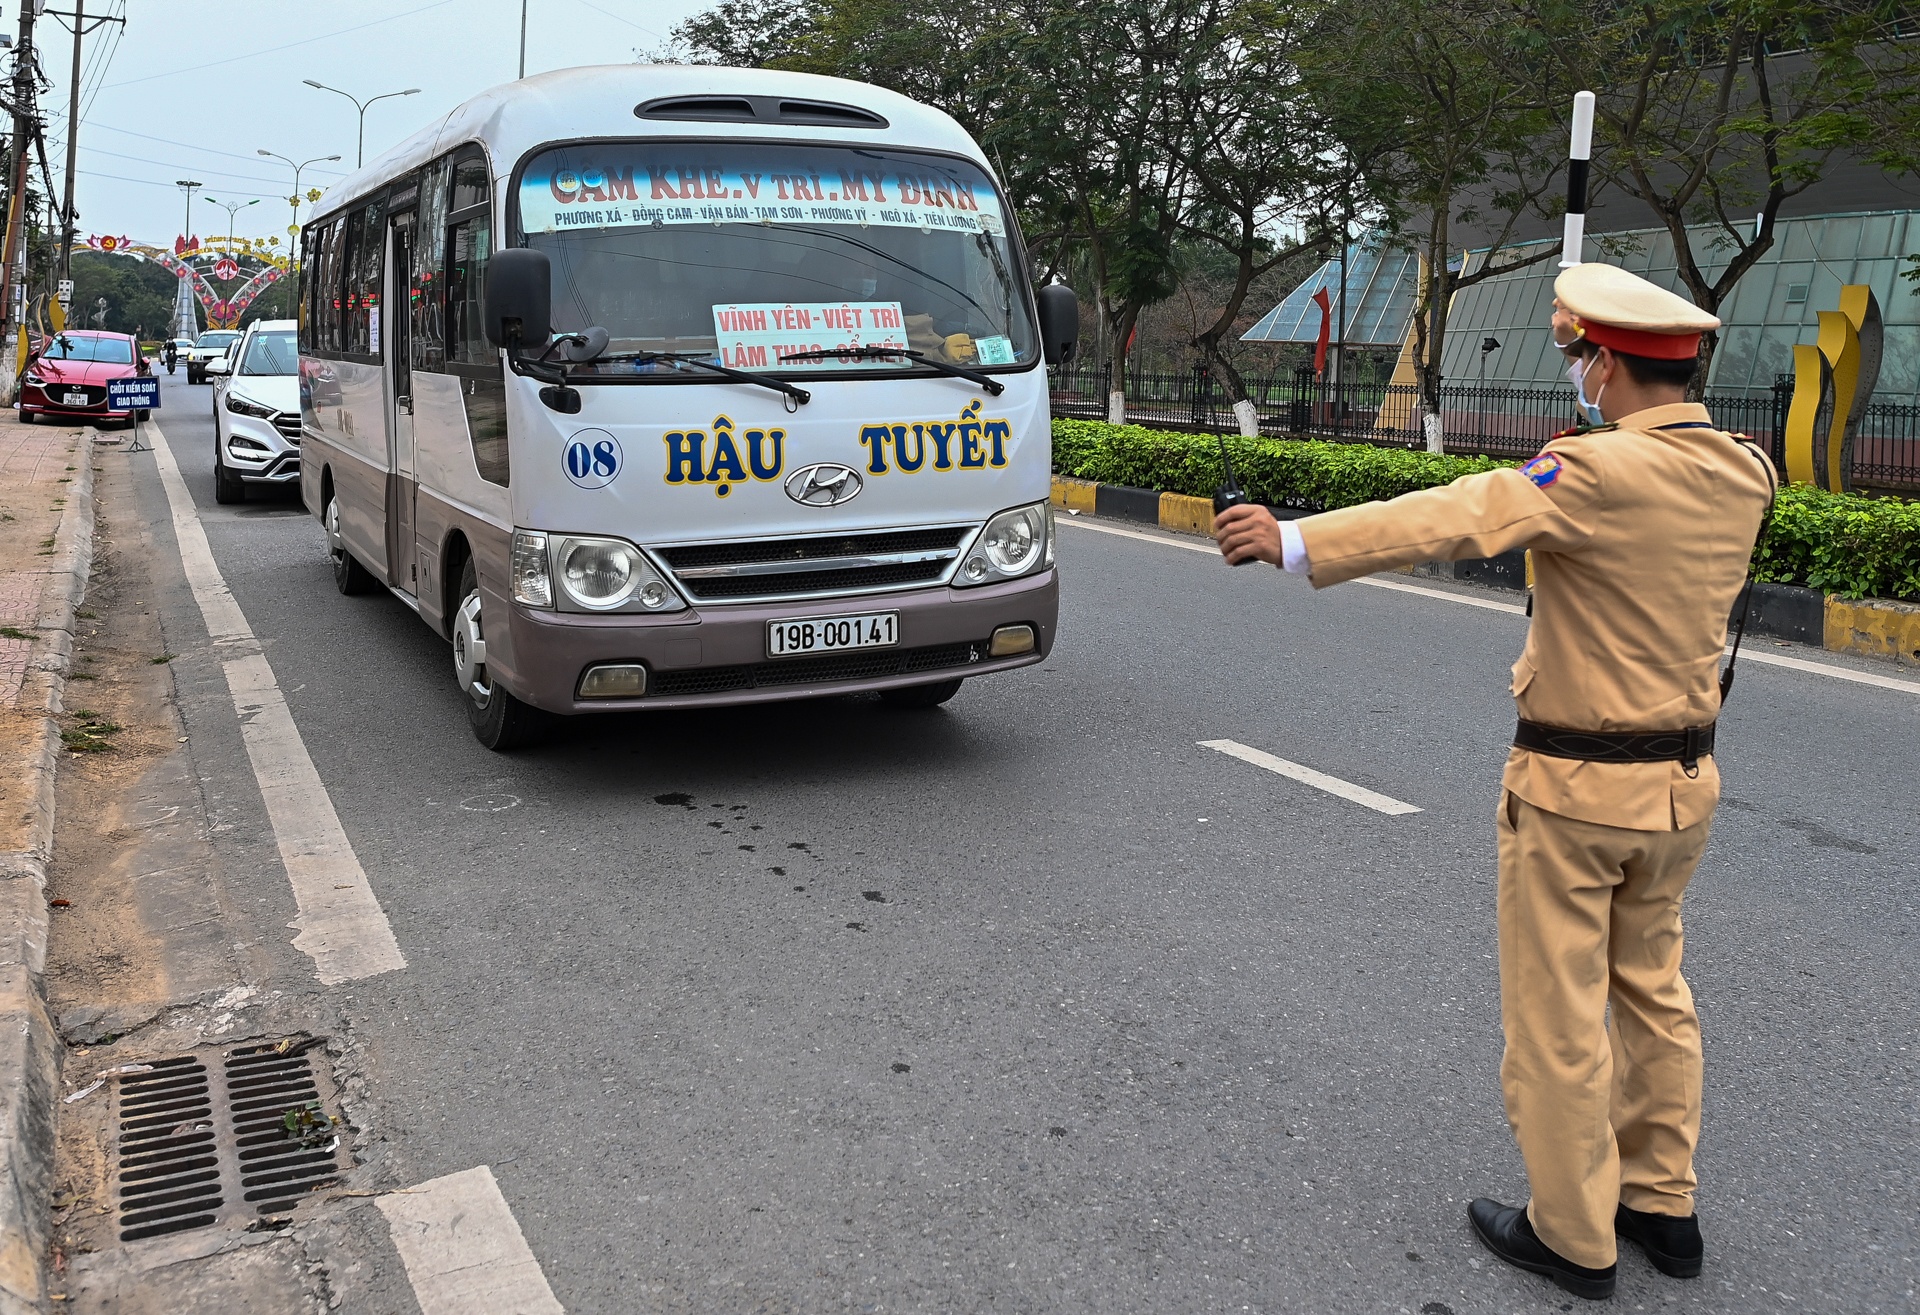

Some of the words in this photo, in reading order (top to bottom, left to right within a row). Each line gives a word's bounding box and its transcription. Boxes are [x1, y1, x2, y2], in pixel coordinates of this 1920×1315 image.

[555, 208, 602, 225] PHƯƠNG
[606, 206, 622, 222] XÁ
[632, 203, 663, 220] ĐỒNG
[667, 207, 693, 219] CAM
[782, 206, 803, 219] SƠN
[811, 207, 853, 222] PHƯỢNG
[855, 206, 867, 221] VỸ
[880, 208, 901, 222] NGÔ
[903, 209, 917, 224] XÁ
[924, 211, 946, 226] TIÊN
[946, 214, 976, 230] LƯƠNG
[717, 306, 767, 332] VĨNH
[870, 304, 901, 329] TRÌ
[722, 342, 767, 368] LÂM
[110, 380, 125, 394] CHỐT
[141, 382, 156, 393] SOÁT
[116, 397, 130, 406] GIAO
[131, 395, 150, 406] THÔNG
[567, 440, 616, 478] 08
[663, 414, 786, 498] HẬU
[859, 398, 1012, 476] TUYẾT
[776, 616, 893, 652] 19B-001.41
